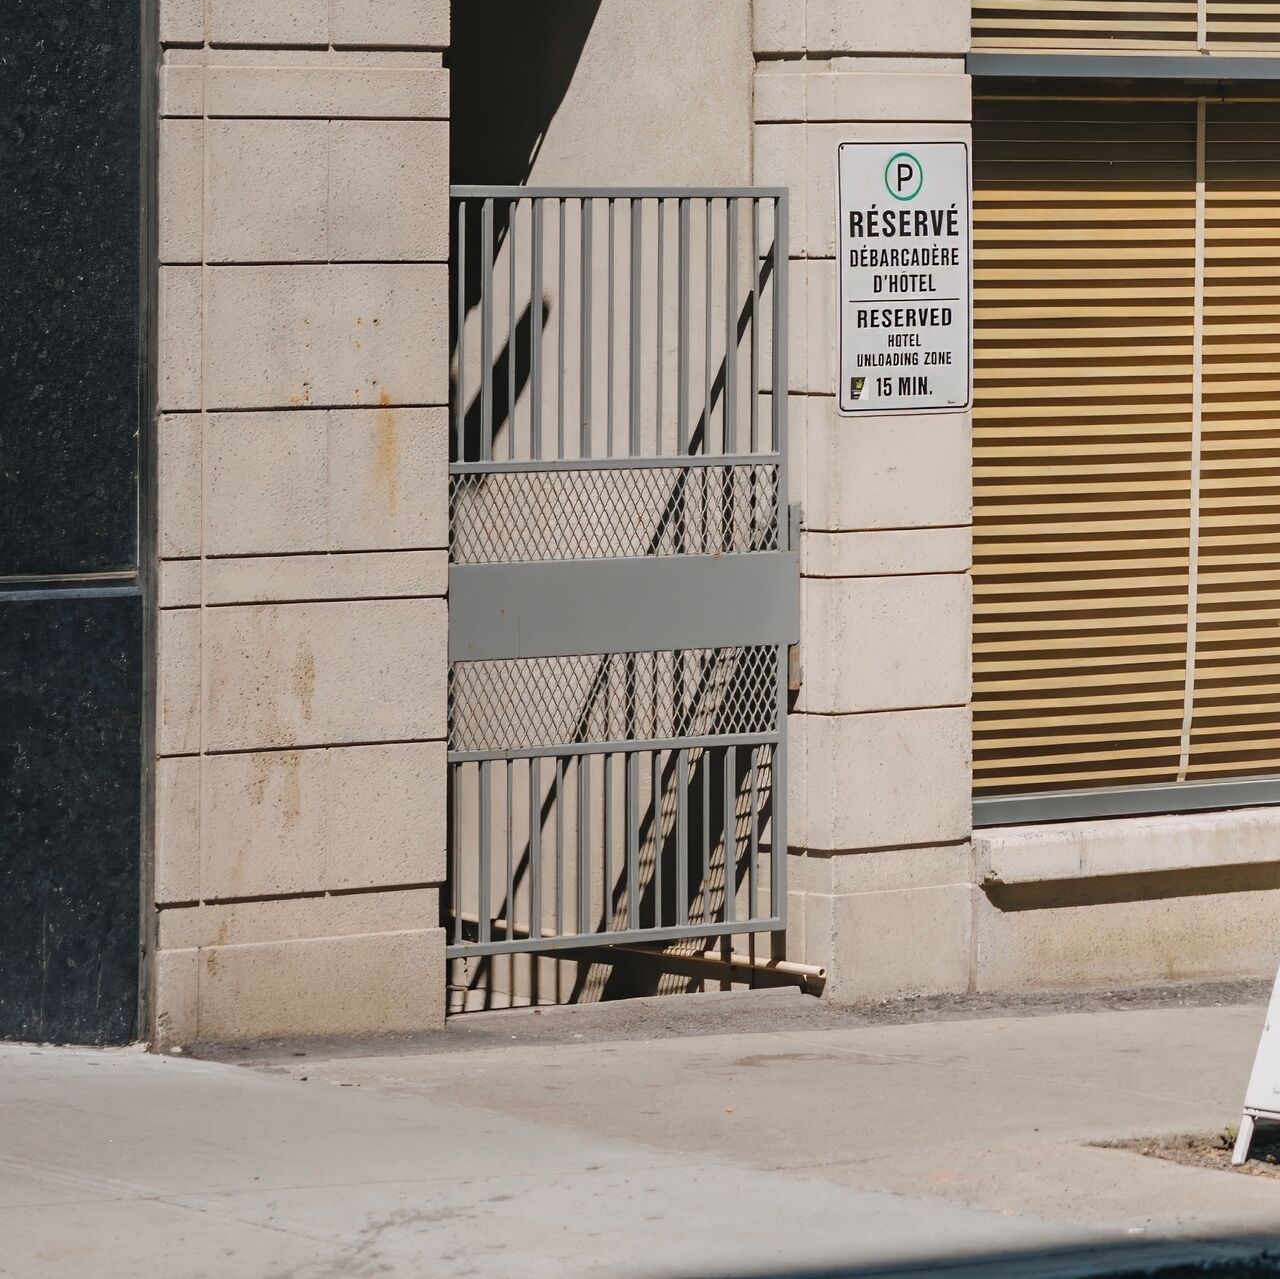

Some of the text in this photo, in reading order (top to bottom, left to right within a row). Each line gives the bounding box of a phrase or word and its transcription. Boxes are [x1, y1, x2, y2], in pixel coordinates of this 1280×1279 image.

[849, 203, 959, 238] RÉSERVÉ
[849, 244, 960, 267] DÉBARCADÈRE
[873, 271, 936, 293] D'HÔTEL
[857, 308, 952, 328] RESERVED
[887, 334, 922, 347] HOTEL
[856, 351, 952, 367] UNLOADING ZONE
[876, 377, 892, 397] 15
[898, 376, 933, 396] MIN.
